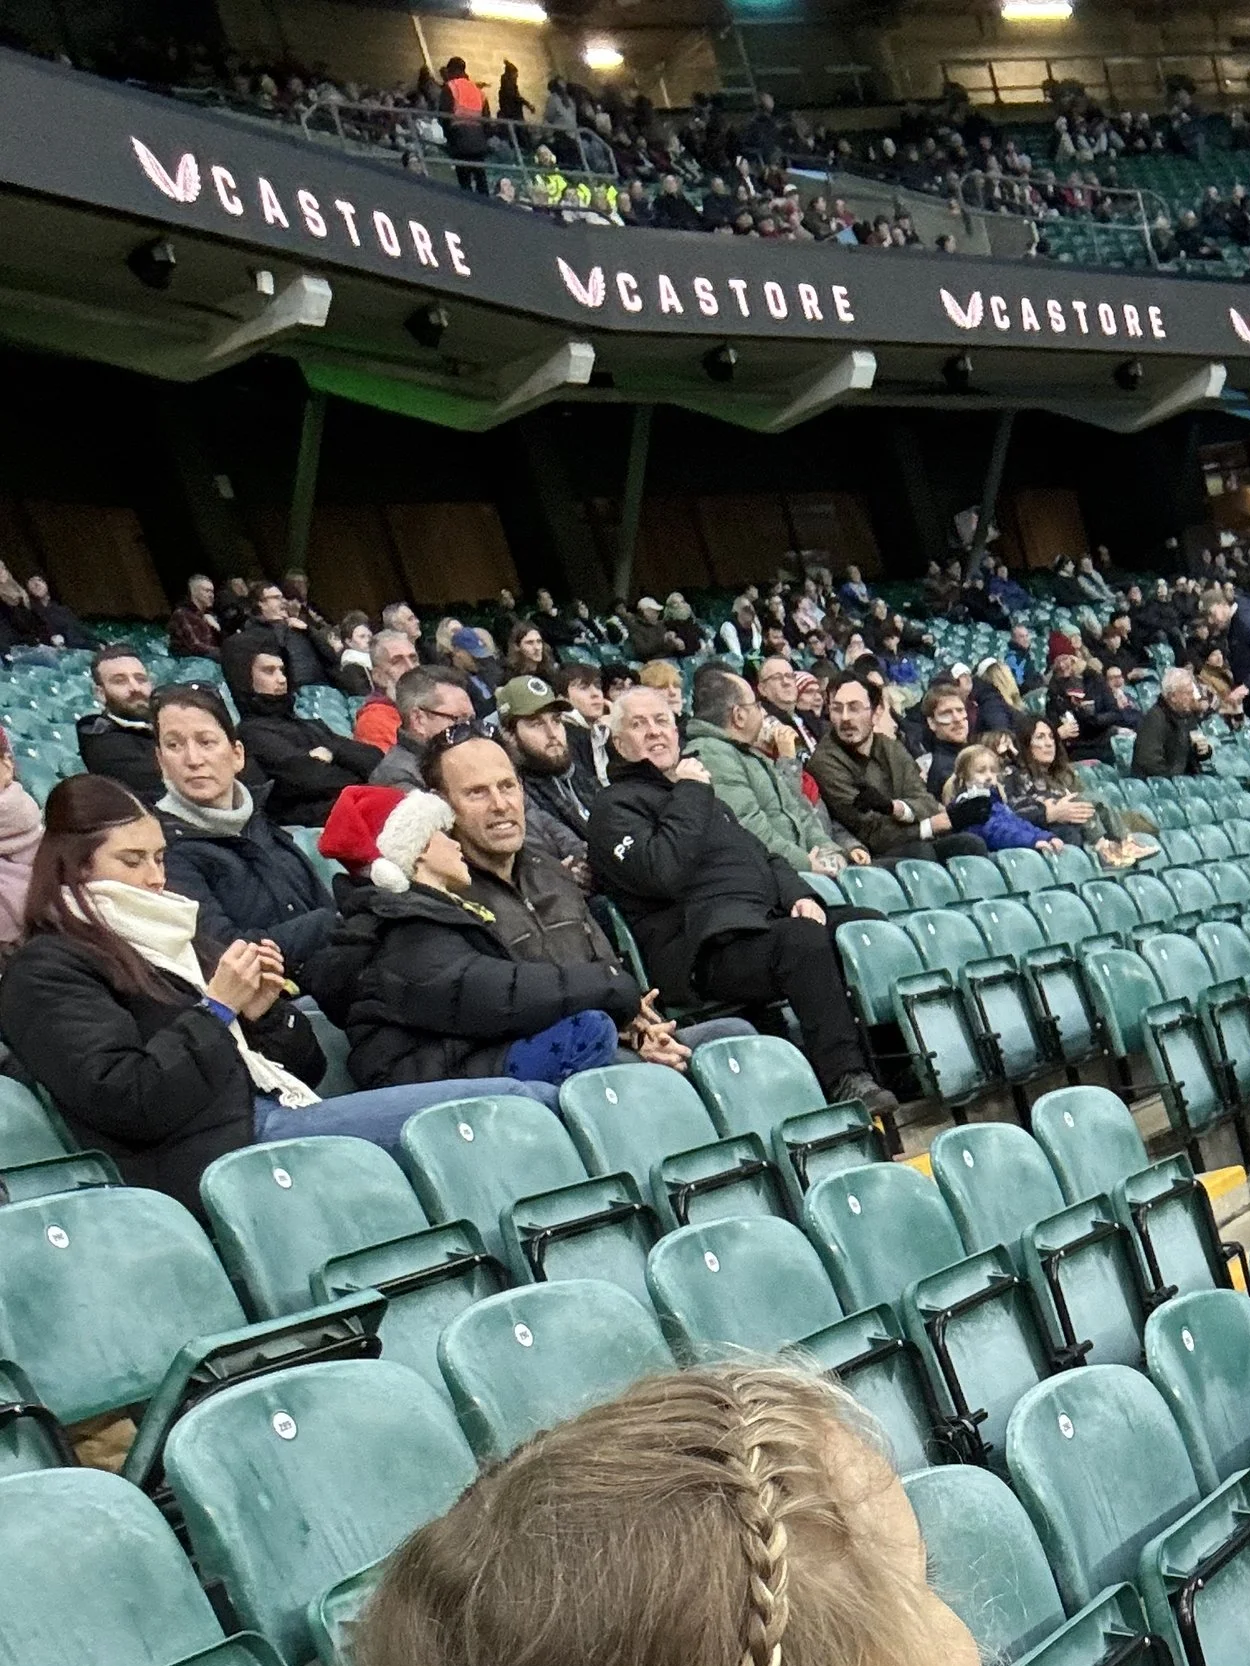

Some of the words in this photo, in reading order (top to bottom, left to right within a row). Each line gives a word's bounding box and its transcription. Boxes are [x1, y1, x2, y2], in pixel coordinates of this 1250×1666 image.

[210, 164, 471, 277] CASTORE
[615, 271, 856, 325] CASTORE
[989, 295, 1167, 339] CASTORE
